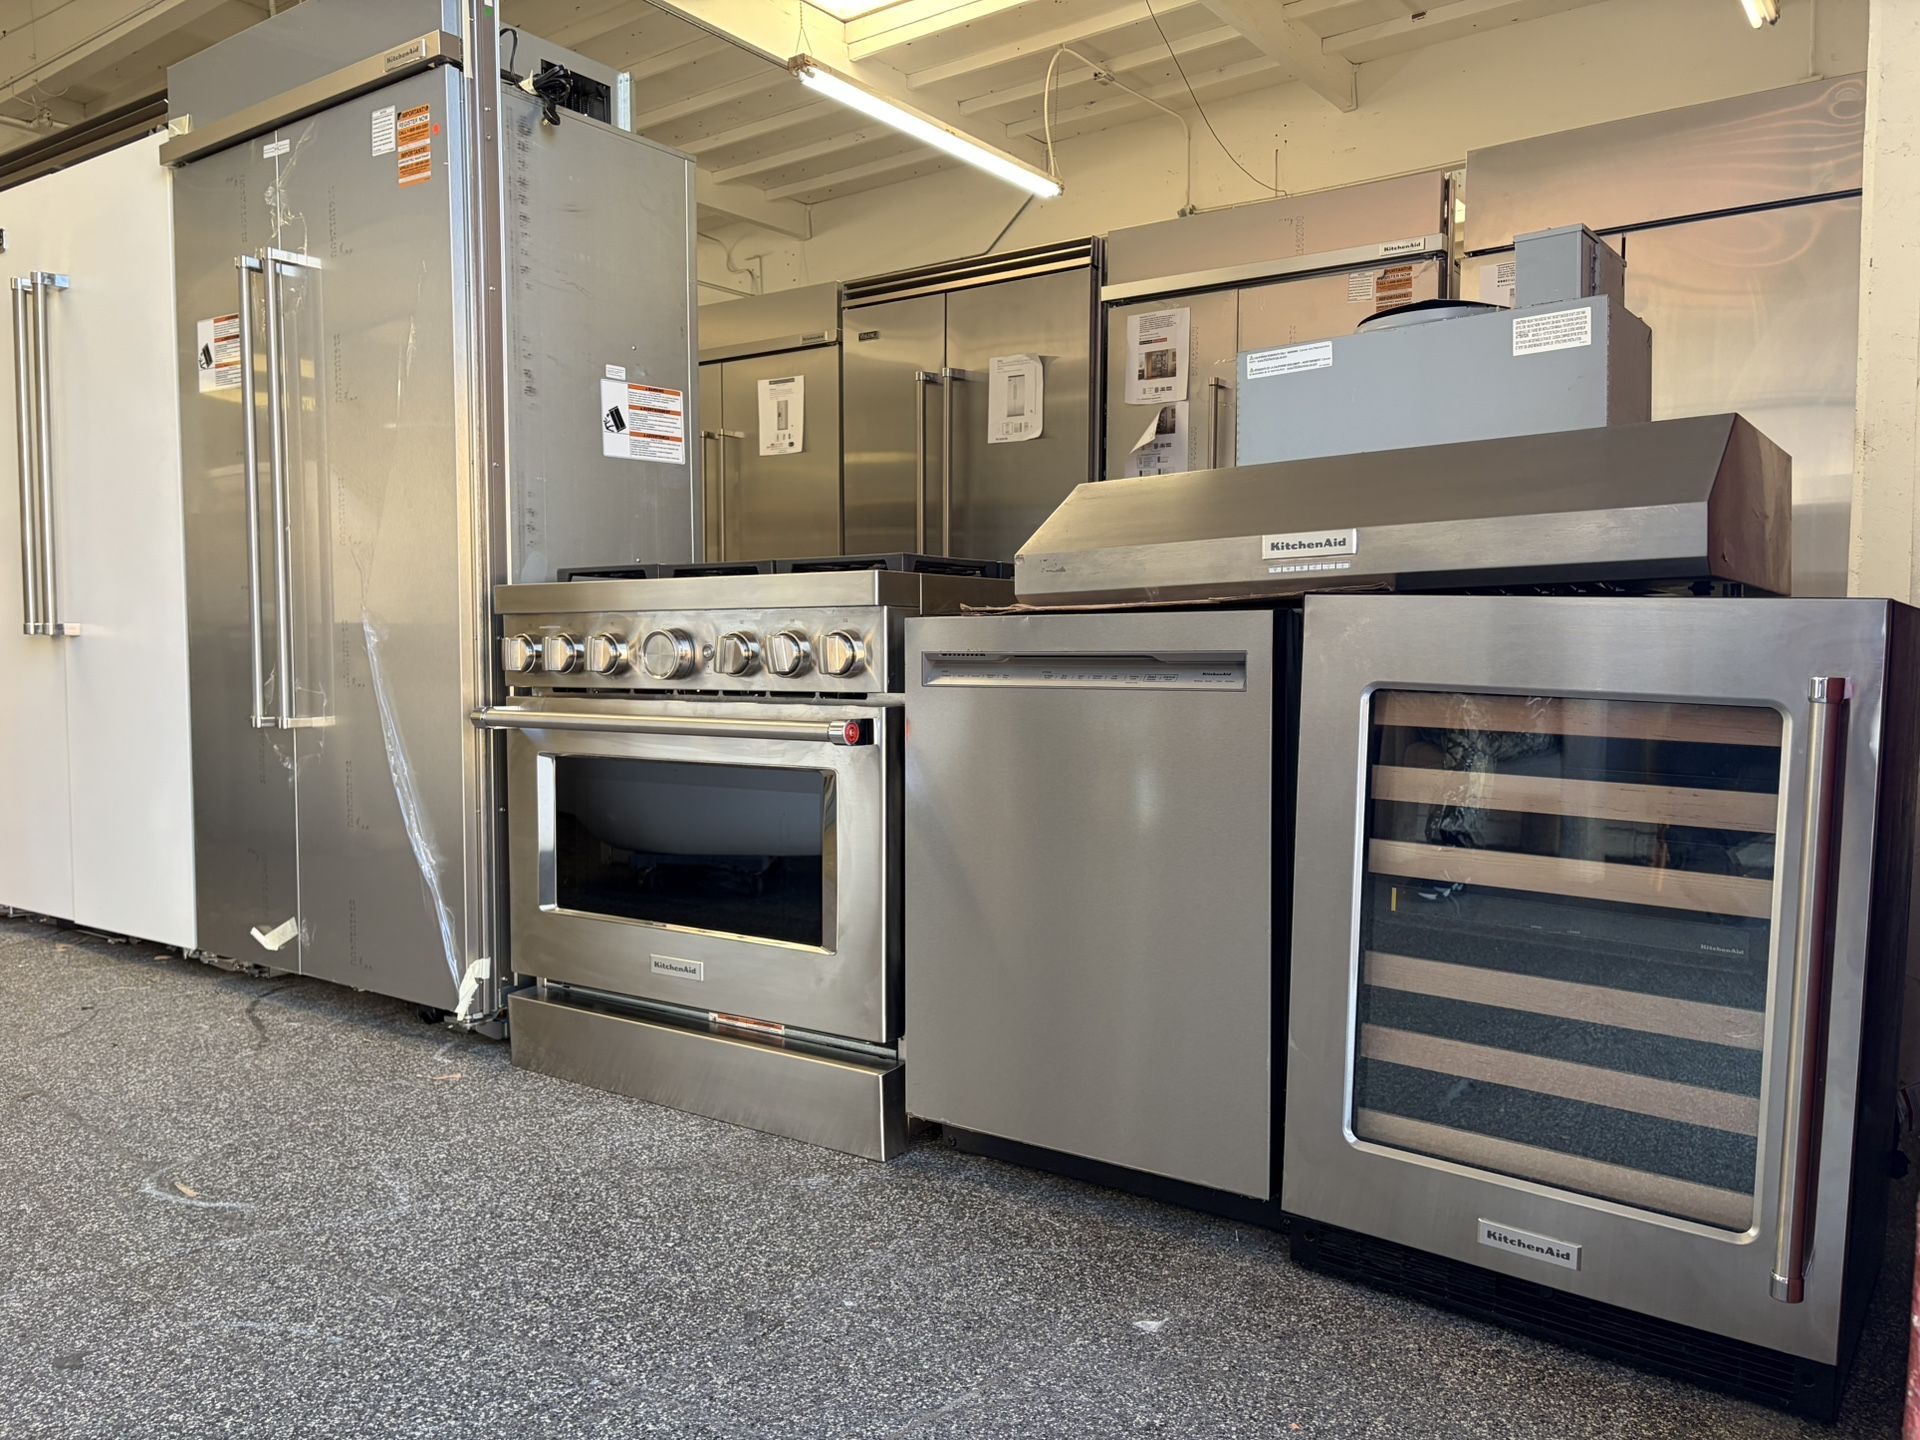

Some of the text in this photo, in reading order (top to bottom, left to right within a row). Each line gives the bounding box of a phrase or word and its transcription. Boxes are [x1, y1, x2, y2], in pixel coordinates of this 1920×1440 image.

[1383, 242, 1421, 252] KitchenAid
[1270, 538, 1347, 551] KitchenAid
[654, 961, 696, 974] KitchenAid
[1487, 1230, 1570, 1260] KitchenAid
